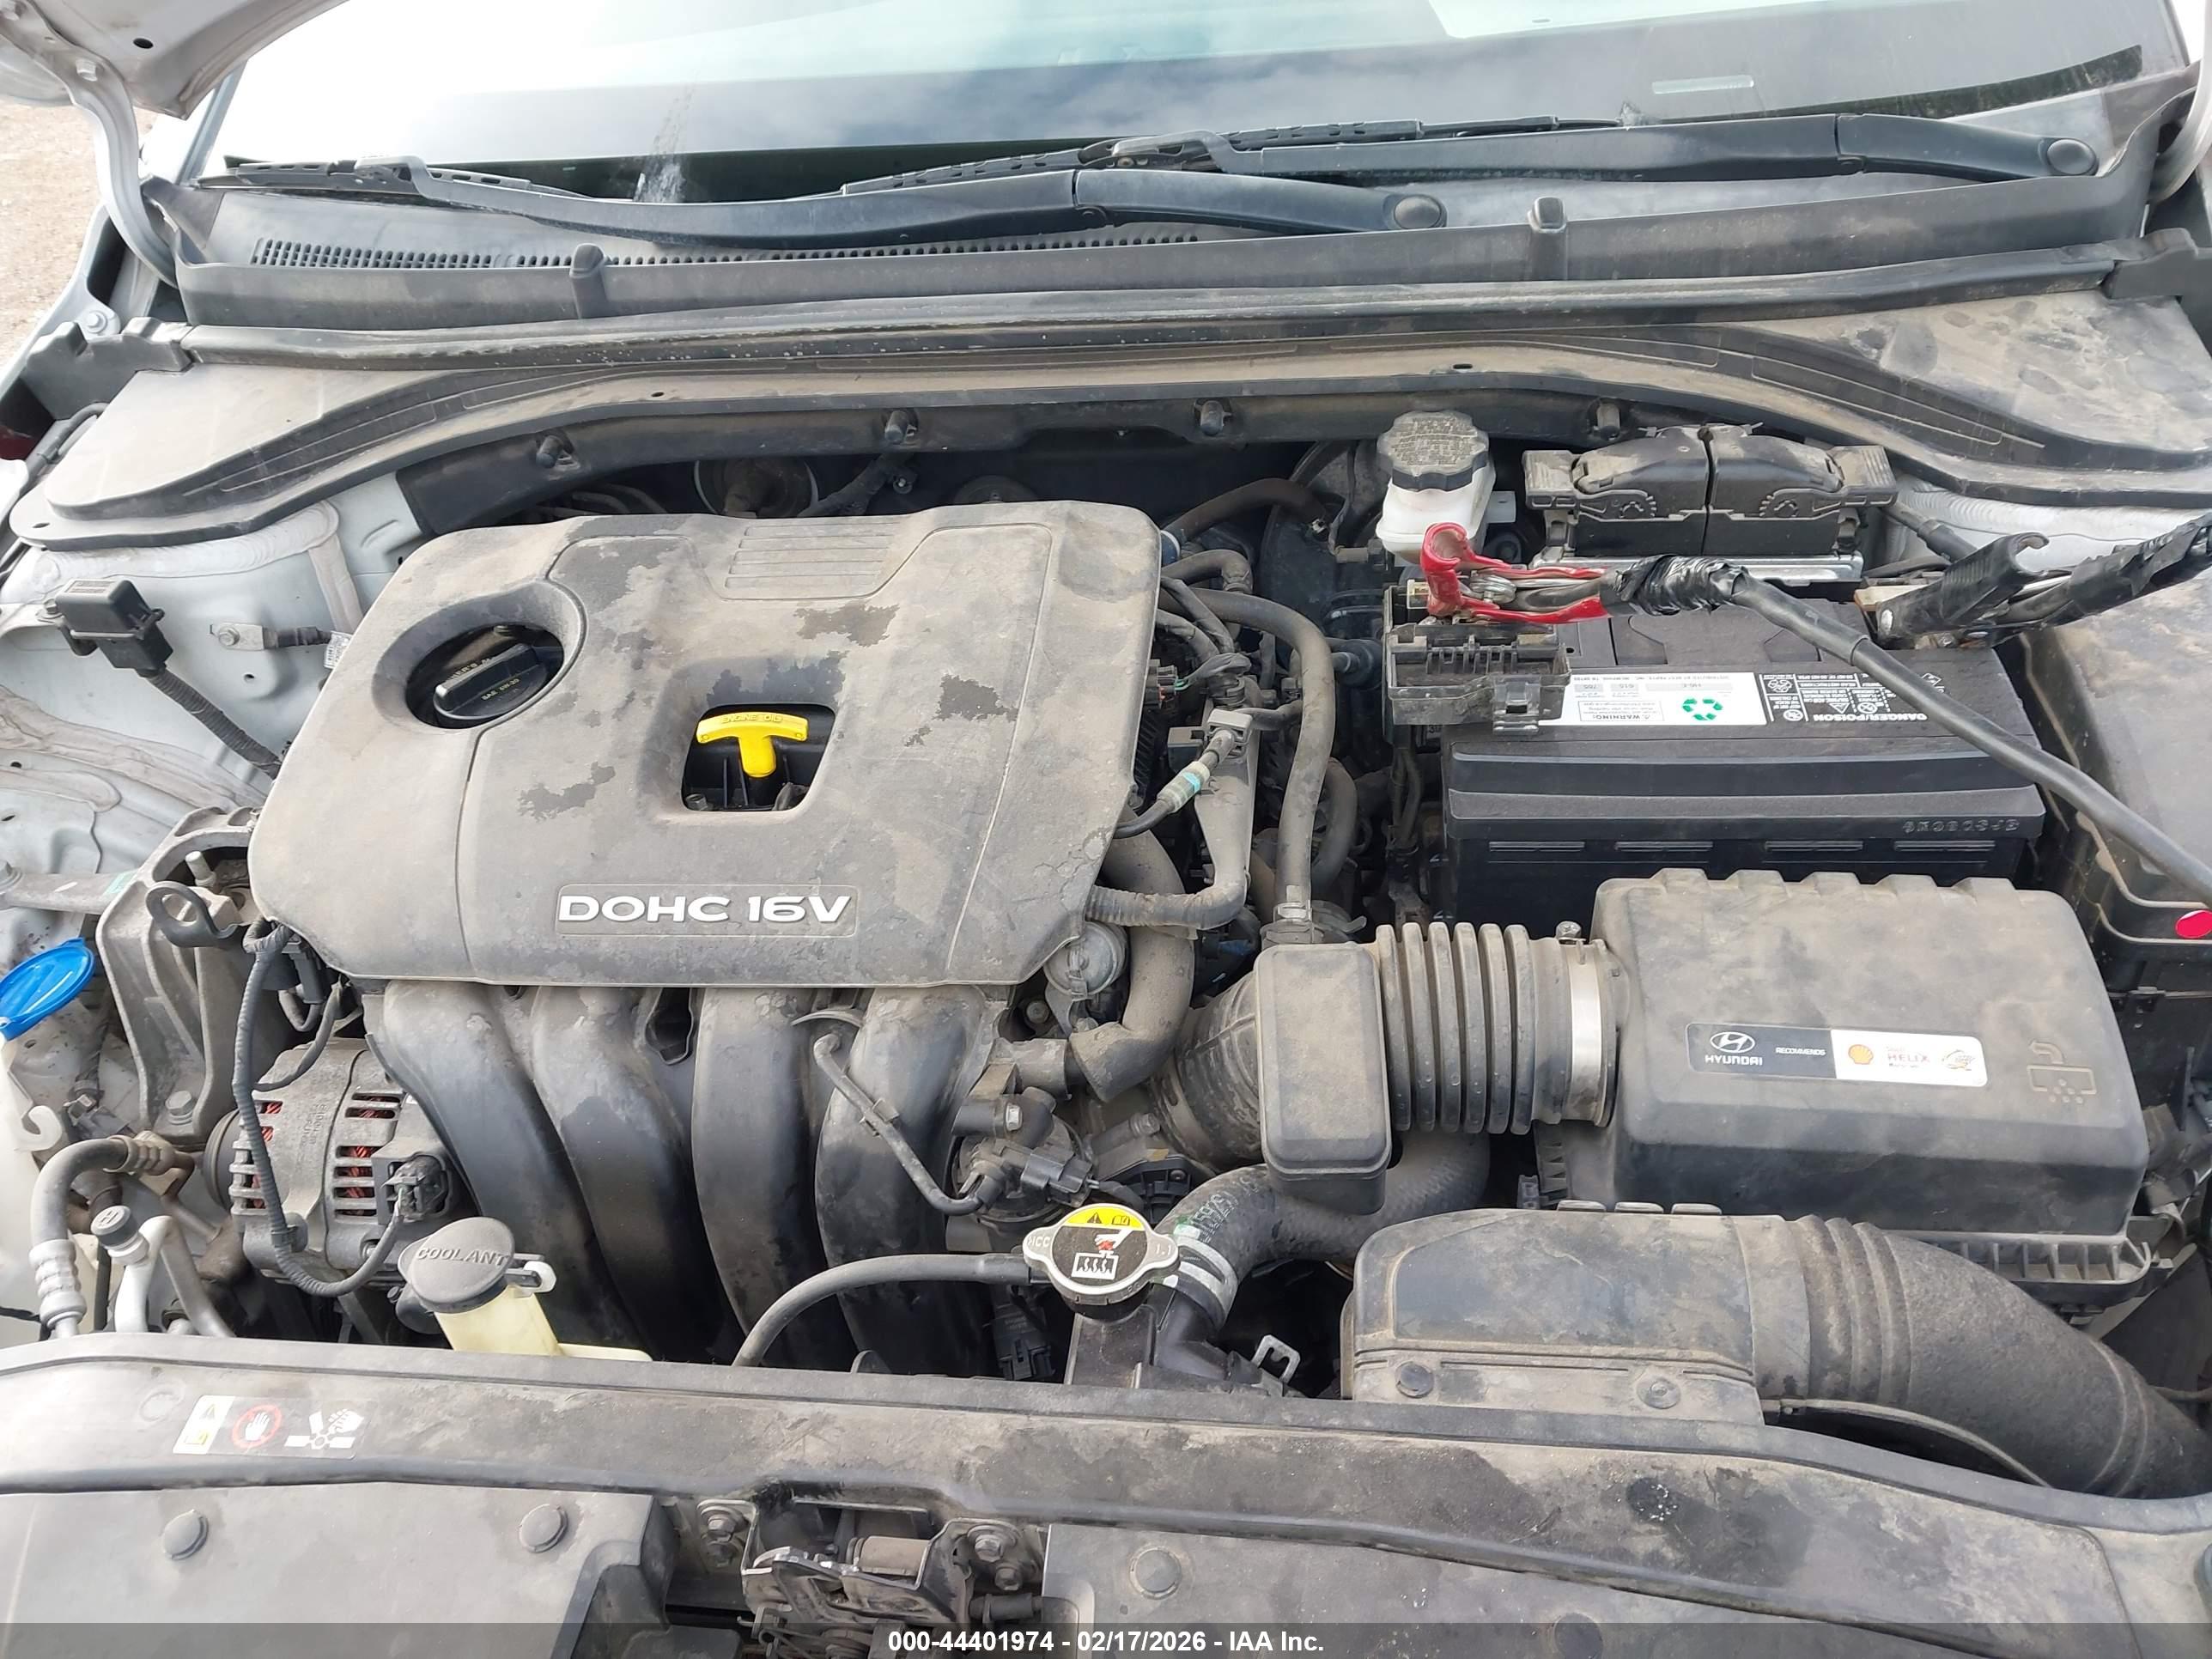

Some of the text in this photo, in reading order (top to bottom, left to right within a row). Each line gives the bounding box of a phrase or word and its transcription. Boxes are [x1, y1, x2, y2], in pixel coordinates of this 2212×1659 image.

[721, 714, 783, 724] ENGINE OIL
[558, 896, 851, 923] DOHC 16V
[1705, 1054, 1763, 1066] HYUNDAI
[417, 1248, 510, 1267] COOLANT
